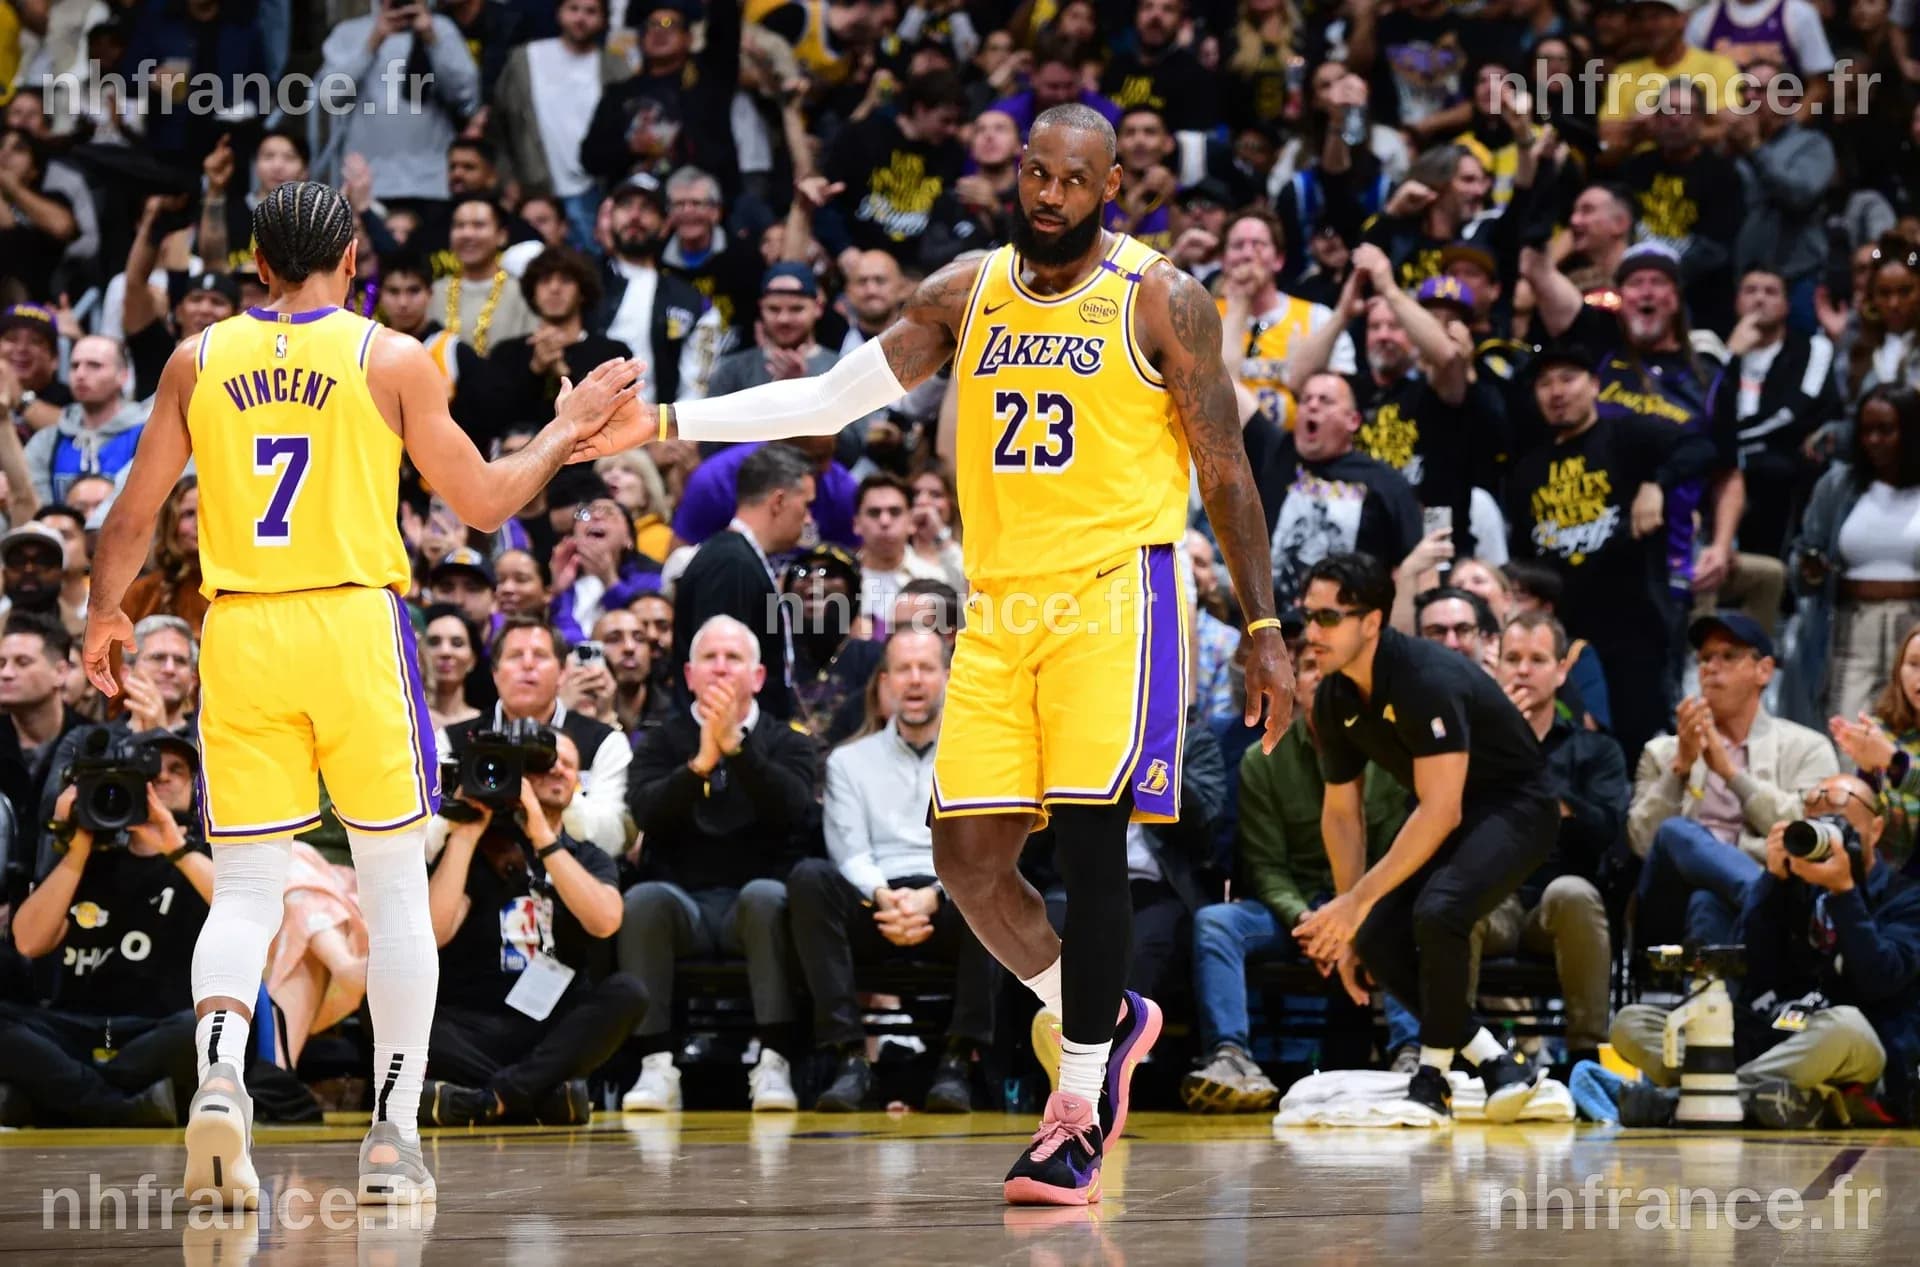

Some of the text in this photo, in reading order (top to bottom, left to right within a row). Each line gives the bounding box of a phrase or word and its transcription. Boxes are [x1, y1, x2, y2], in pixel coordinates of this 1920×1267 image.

[1082, 303, 1117, 317] bibigo
[973, 325, 1105, 376] LAKERS
[222, 367, 338, 413] VINCENT
[993, 390, 1075, 472] 23
[255, 436, 311, 544] 7
